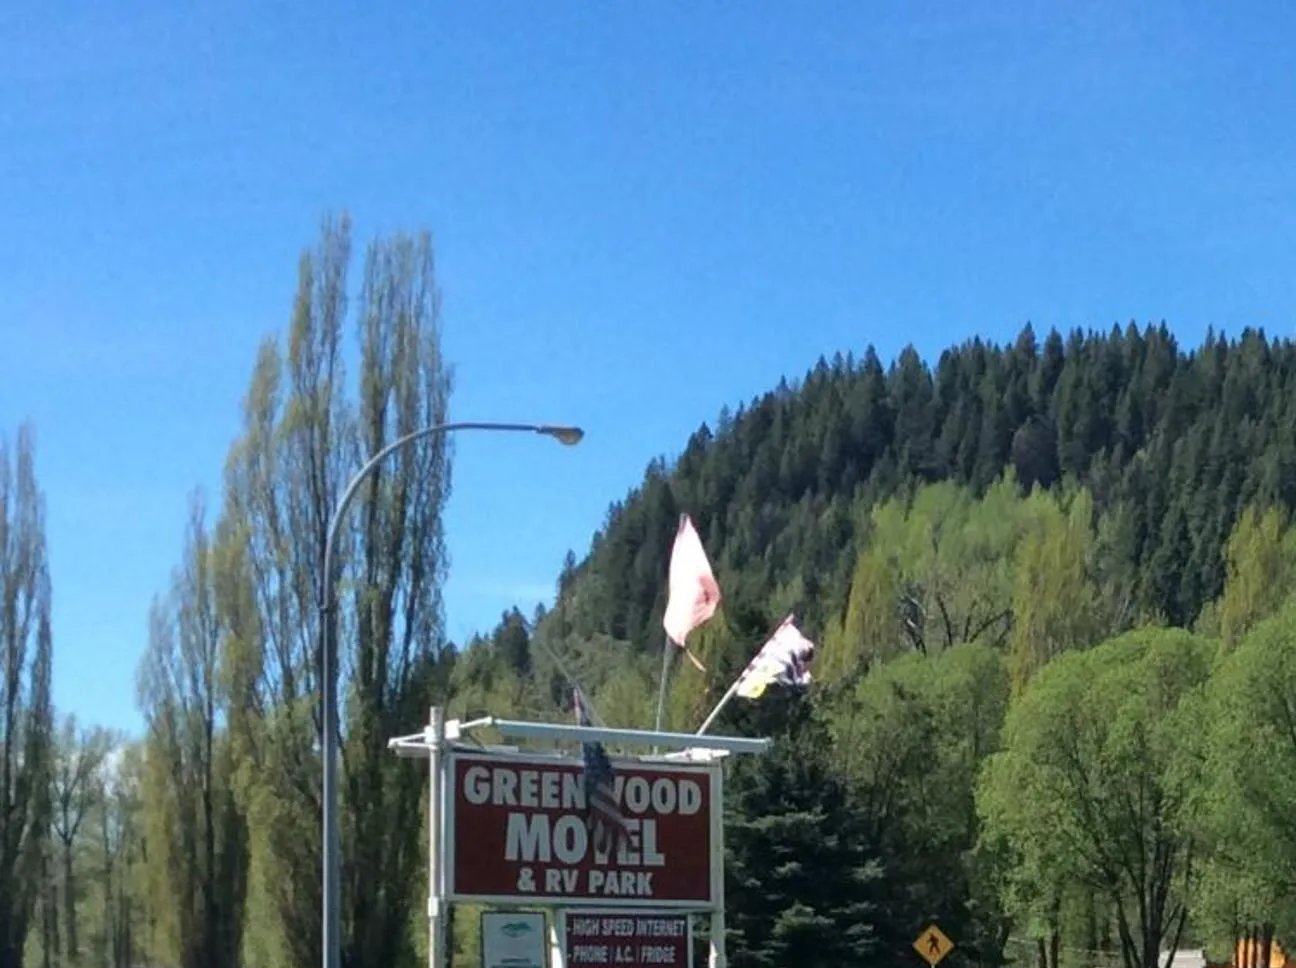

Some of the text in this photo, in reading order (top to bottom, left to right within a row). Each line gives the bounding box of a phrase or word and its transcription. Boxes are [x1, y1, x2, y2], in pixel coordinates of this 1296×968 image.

[463, 766, 701, 815] GREENOOD
[516, 867, 653, 896] & RV PARK
[602, 918, 635, 936] SPEED
[636, 919, 685, 936] INTERNET
[573, 946, 608, 963] PHONE
